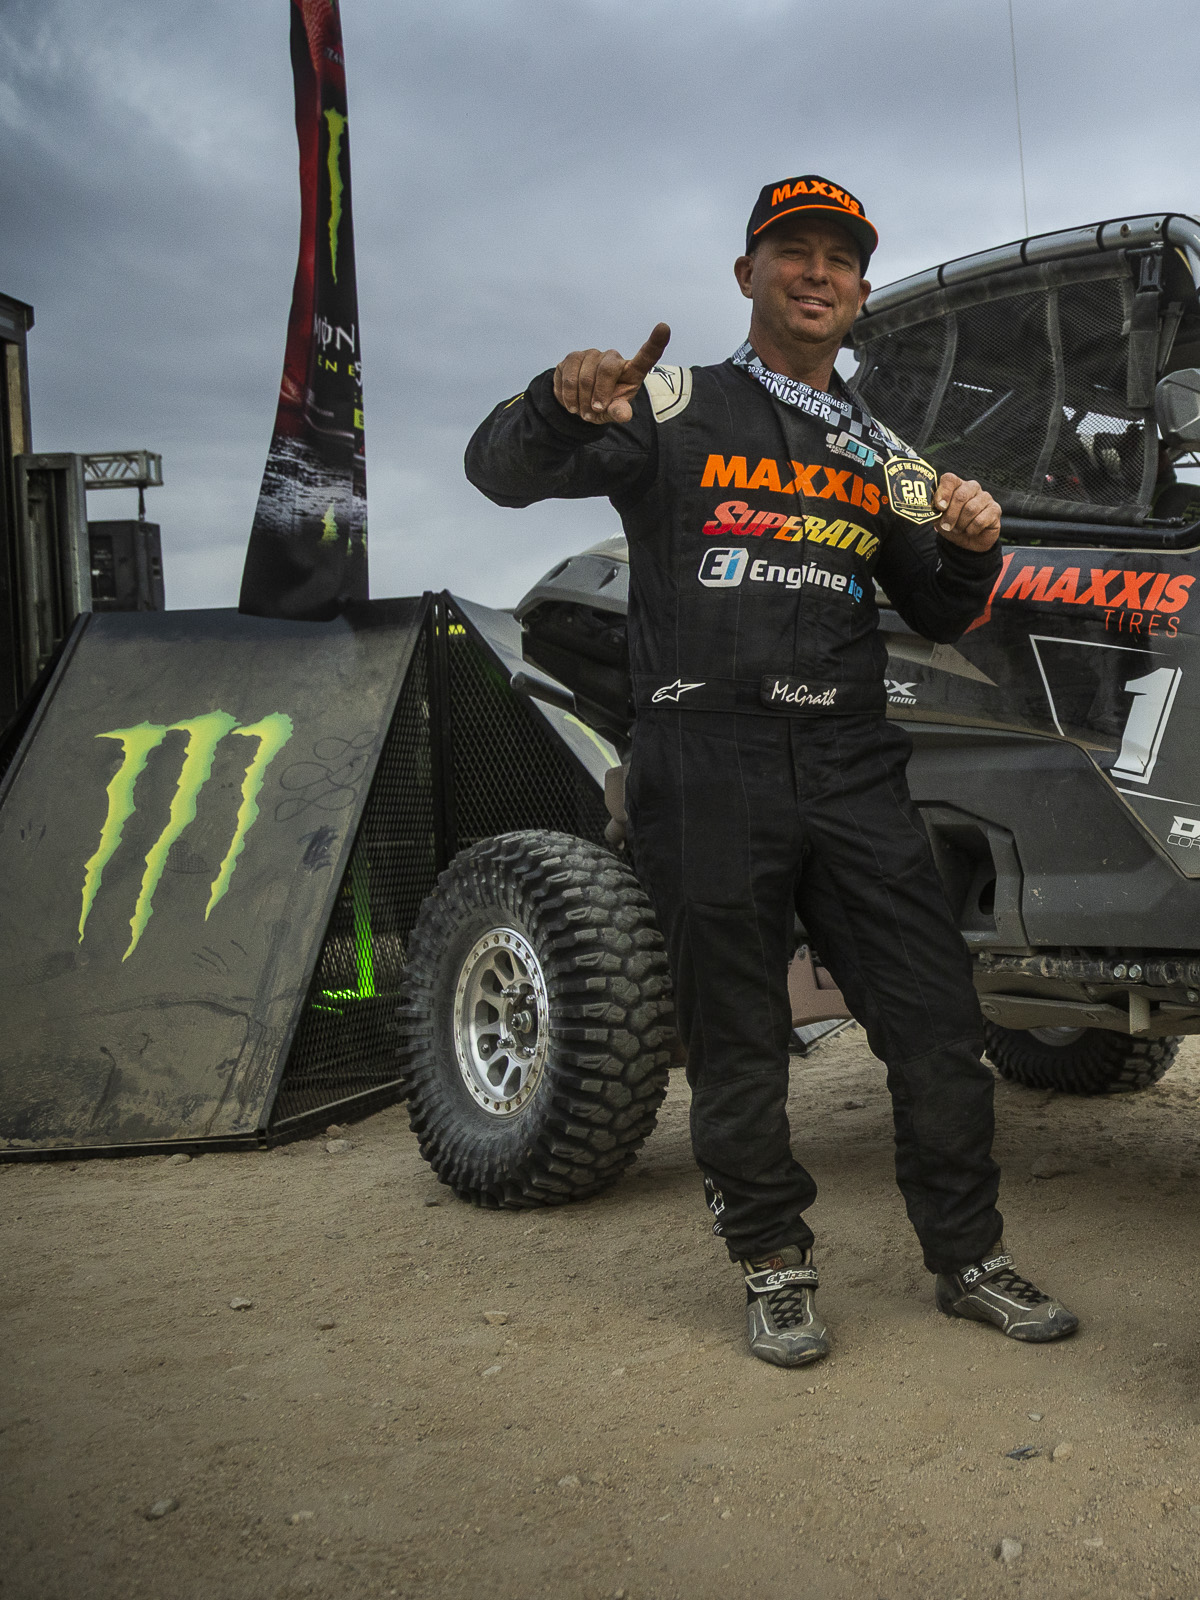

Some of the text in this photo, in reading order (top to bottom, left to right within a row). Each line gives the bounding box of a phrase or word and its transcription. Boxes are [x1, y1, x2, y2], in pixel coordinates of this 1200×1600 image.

[772, 181, 860, 215] MAXXIS
[748, 365, 850, 413] 2026 KING OF THE HAMMERS
[758, 375, 832, 421] FINISHER
[700, 454, 882, 516] MAXXIS
[900, 479, 928, 499] 20
[904, 496, 929, 506] YEARS
[749, 559, 848, 592] Engine
[1002, 566, 1197, 614] MAXXIS
[1103, 609, 1181, 639] TIRES
[771, 680, 838, 707] McGrath
[888, 695, 918, 705] 1000
[1110, 667, 1184, 785] 1
